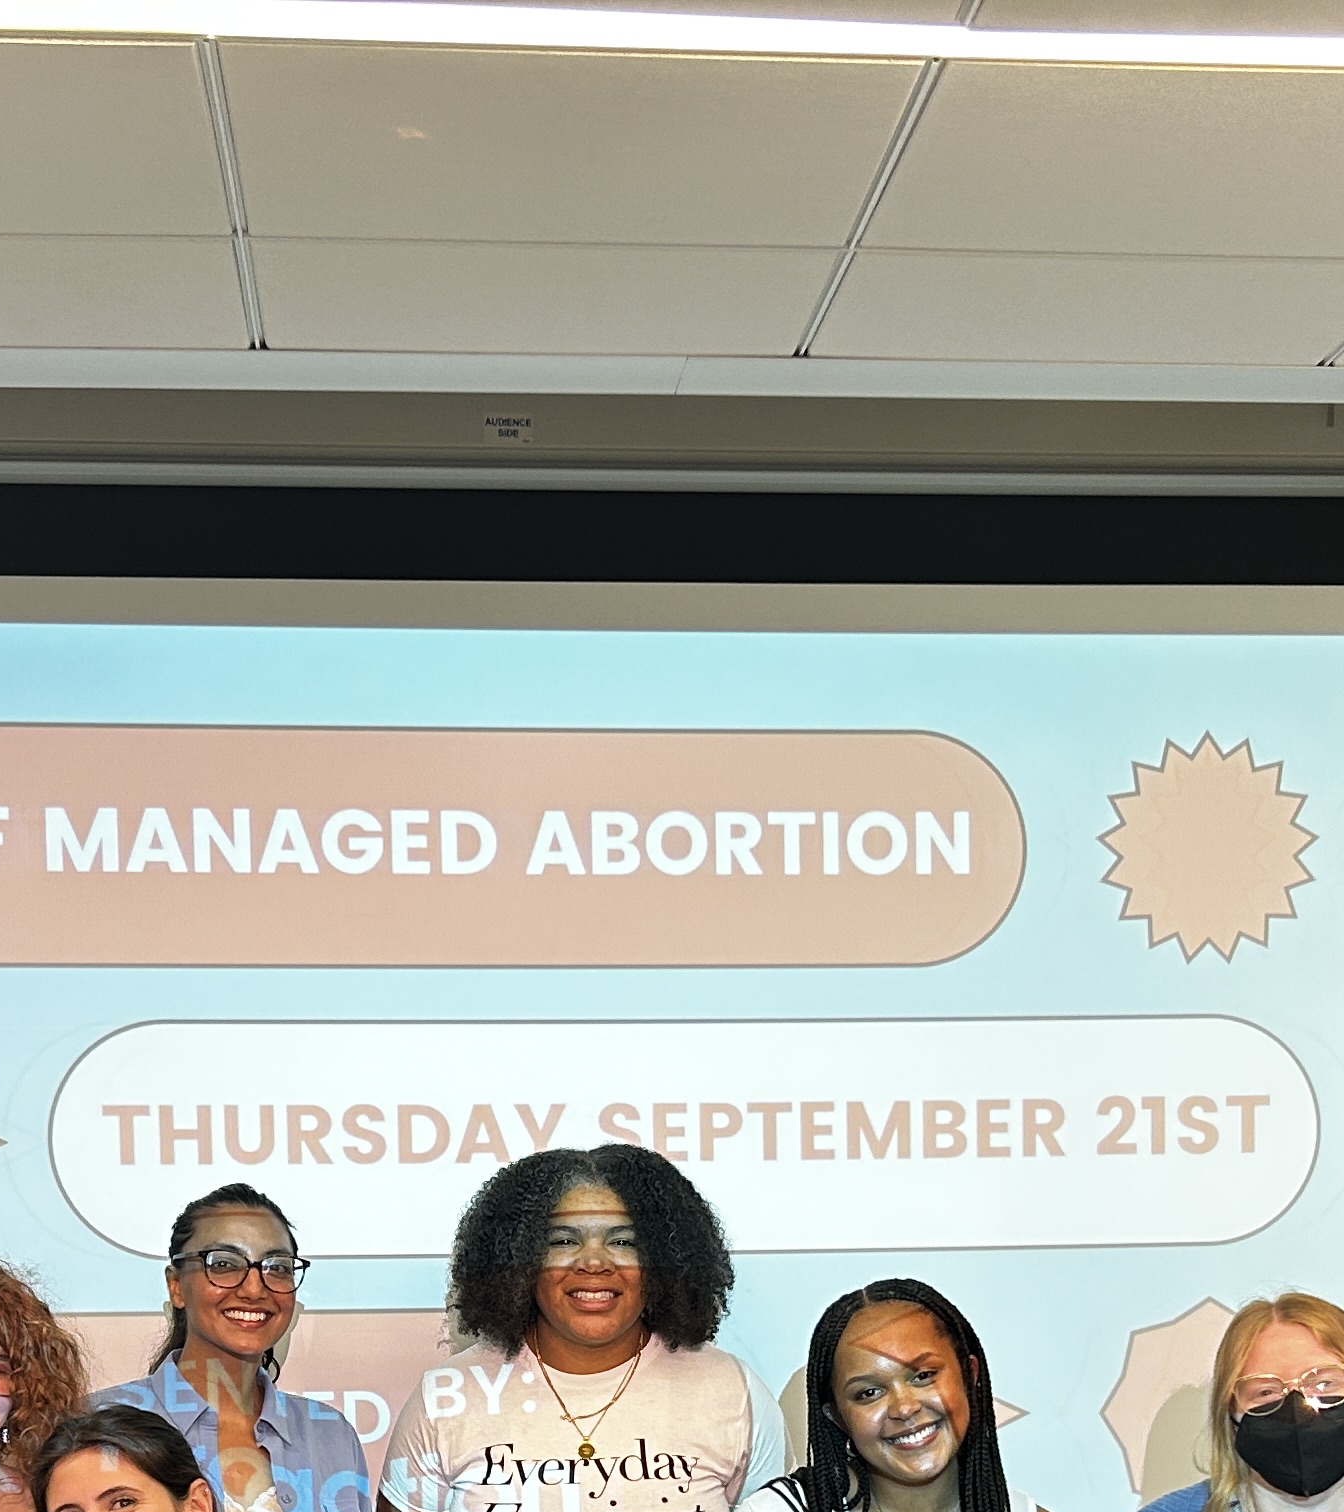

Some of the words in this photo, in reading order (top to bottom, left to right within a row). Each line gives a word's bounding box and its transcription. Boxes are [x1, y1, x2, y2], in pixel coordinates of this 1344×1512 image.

[44, 806, 498, 875] MANAGED
[524, 809, 971, 876] ABORTION
[101, 1102, 567, 1166] THURSDAY
[597, 1097, 1066, 1163] SEPTEMBER
[1095, 1093, 1272, 1156] 21ST
[422, 1362, 536, 1419] BY:
[479, 1438, 700, 1499] Everyday
